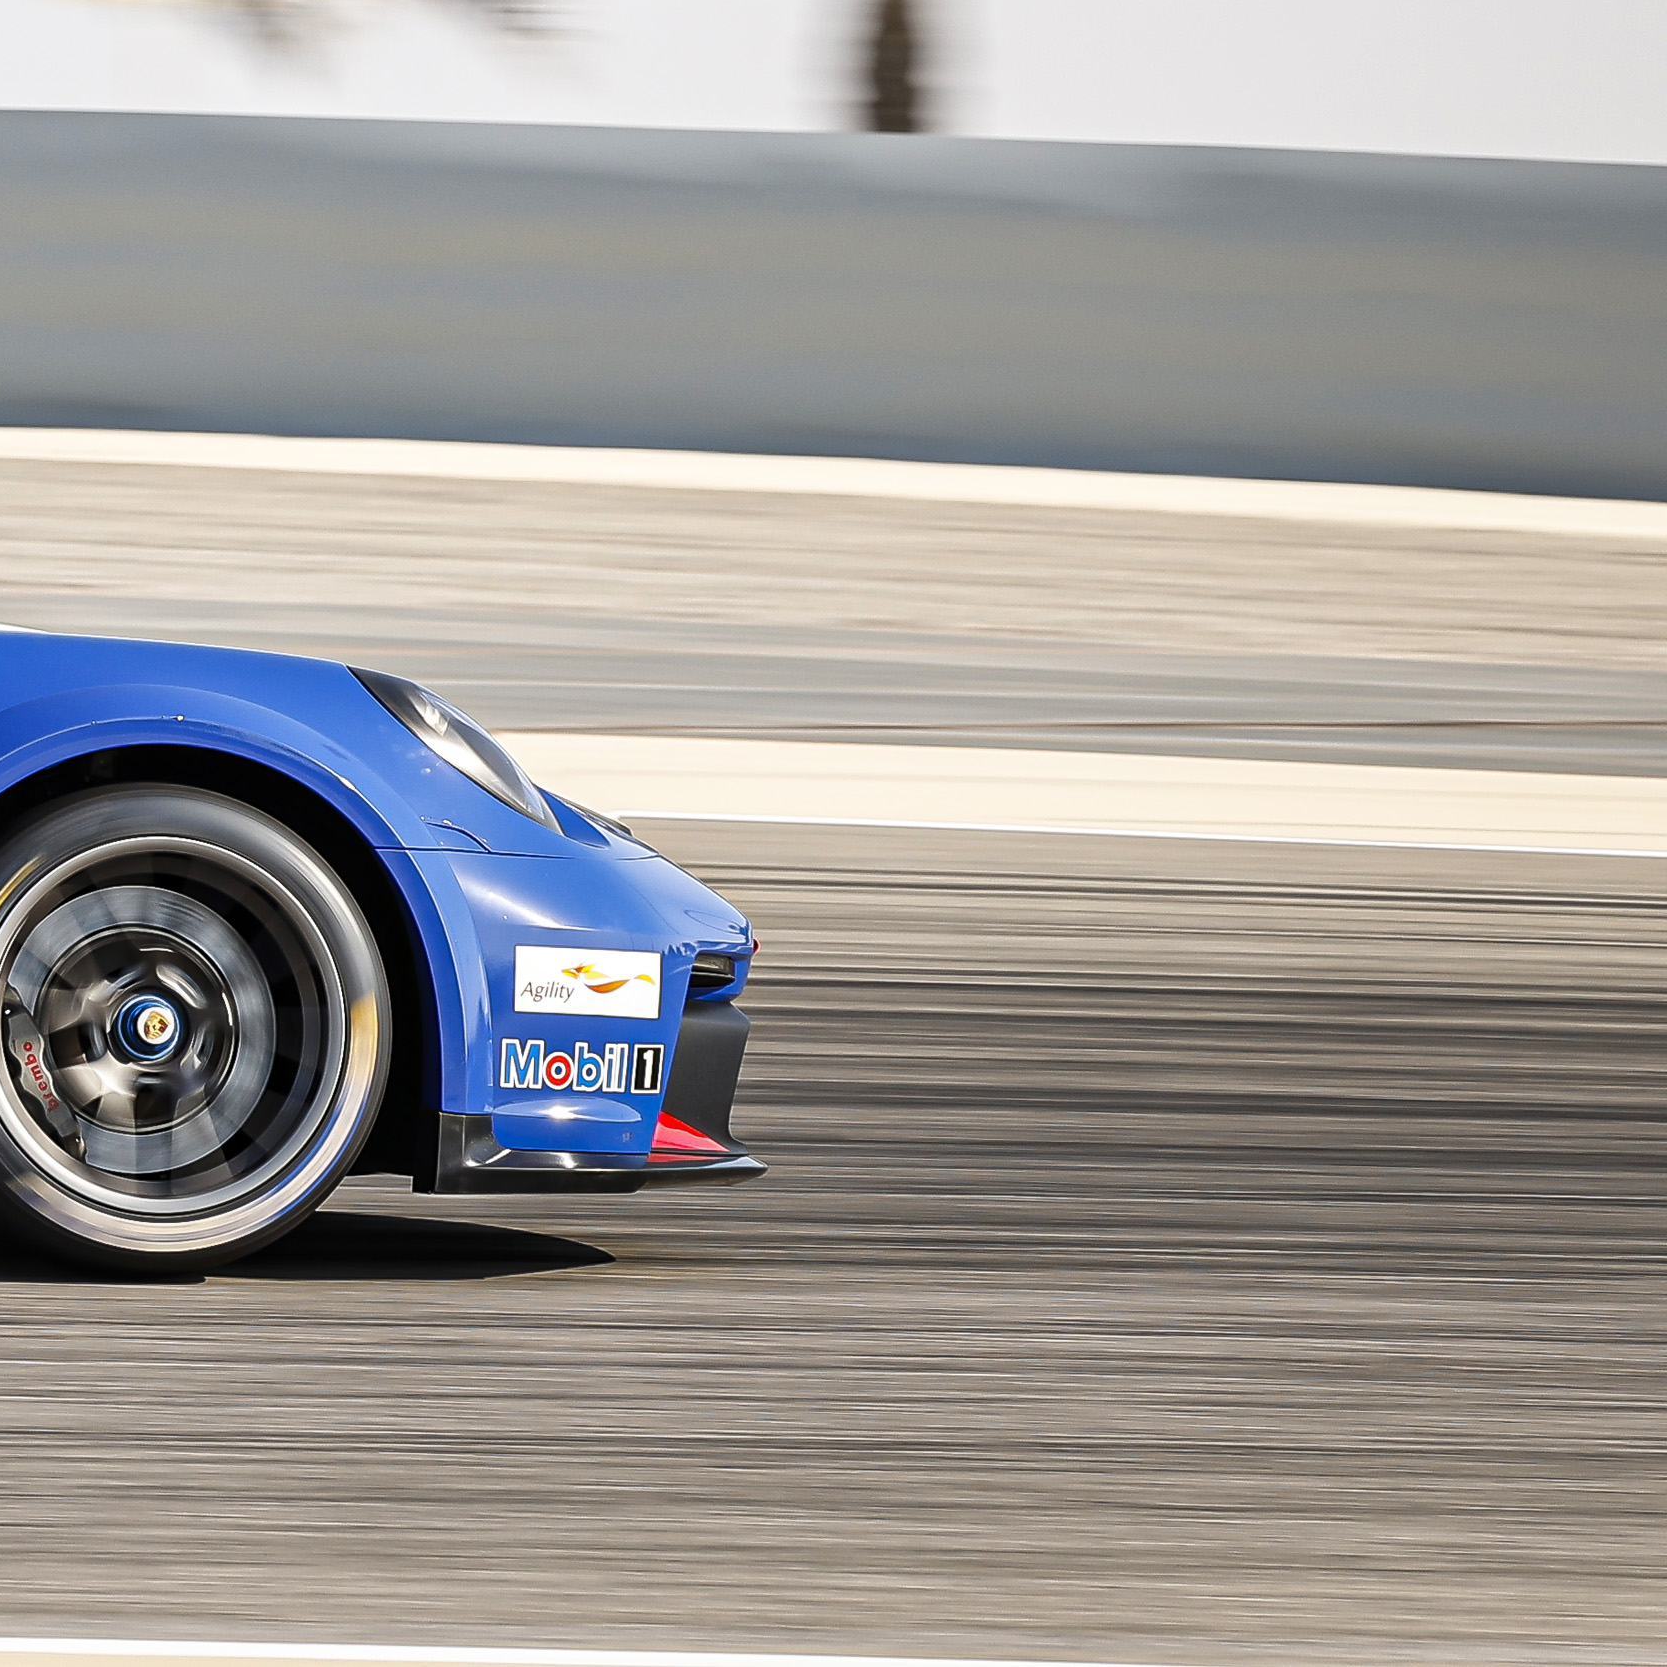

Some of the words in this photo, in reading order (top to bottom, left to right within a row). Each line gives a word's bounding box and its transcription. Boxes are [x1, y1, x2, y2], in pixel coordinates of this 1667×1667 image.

[520, 979, 576, 1003] Agility
[22, 1041, 60, 1113] brembo
[499, 1038, 630, 1094] Mobil
